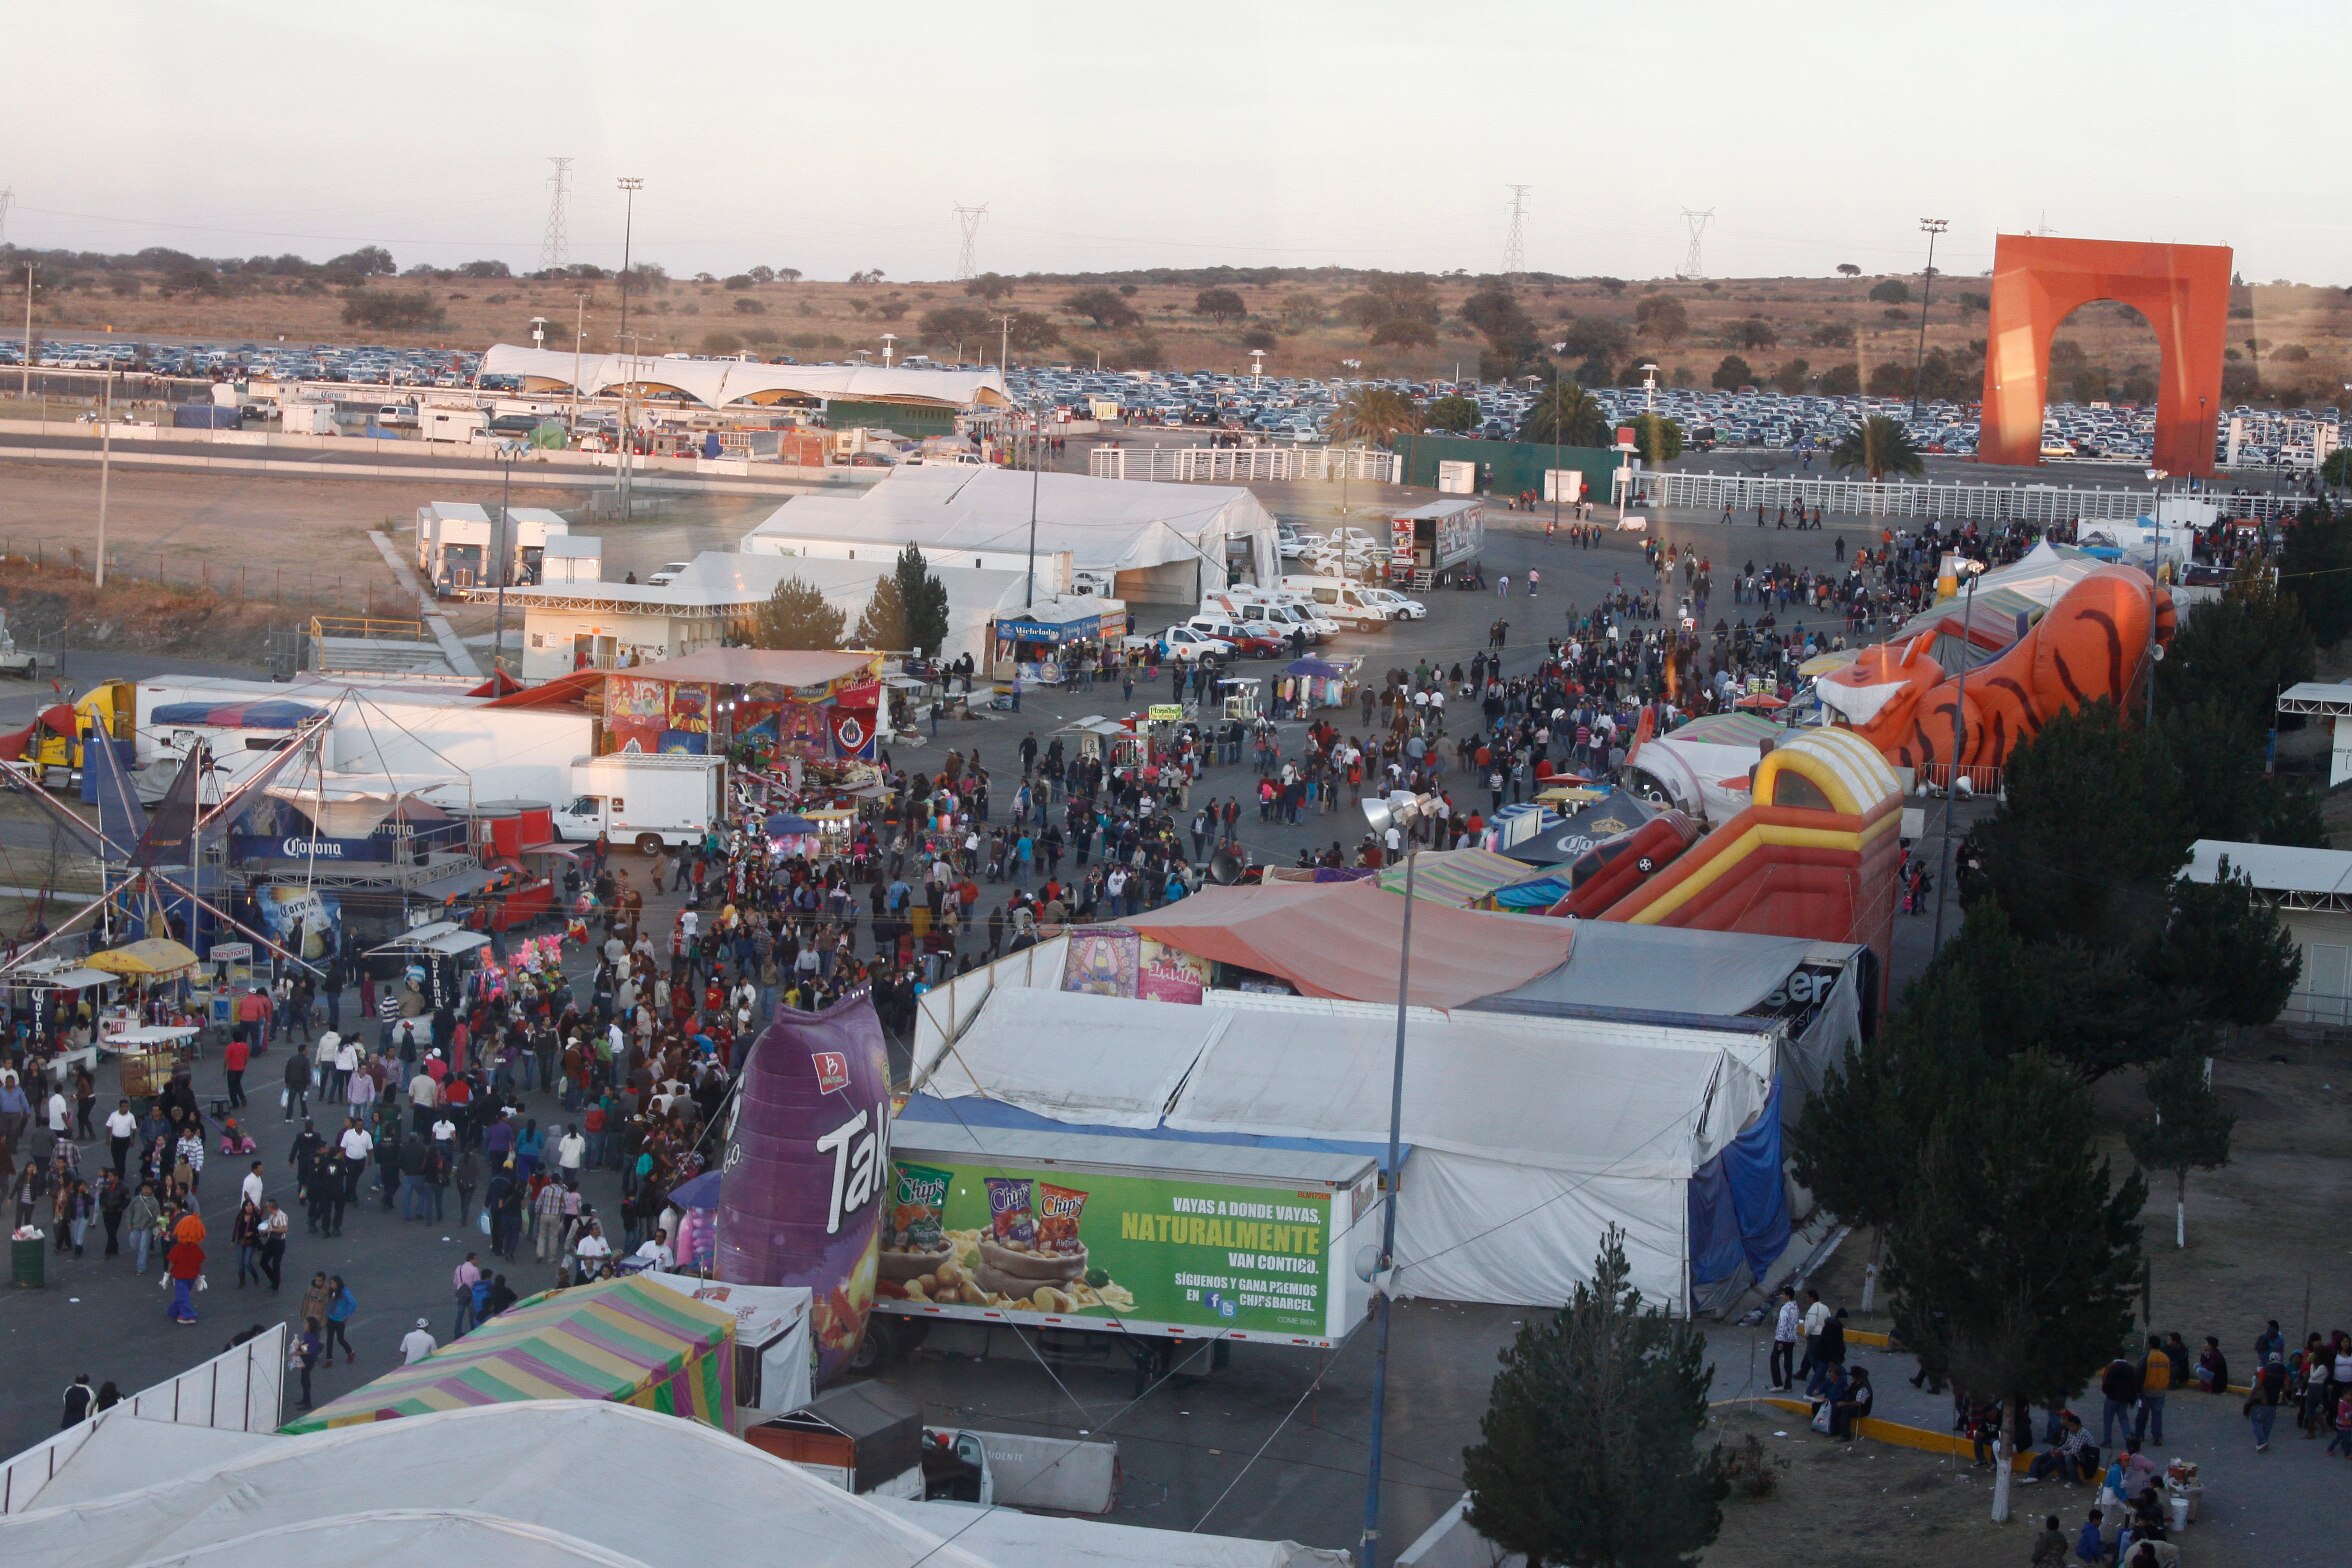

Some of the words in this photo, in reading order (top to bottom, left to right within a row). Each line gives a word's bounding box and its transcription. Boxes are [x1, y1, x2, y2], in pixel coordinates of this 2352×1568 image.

[1015, 627, 1060, 636] Micheladas
[843, 678, 876, 693] MINNIE
[372, 821, 415, 838] orona
[283, 837, 342, 859] Corona
[896, 1178, 946, 1206] Chip's
[990, 1183, 1031, 1212] Chip's
[1041, 1195, 1084, 1218] Chip's
[1173, 1198, 1215, 1215] VAYAS
[1217, 1201, 1227, 1216] A
[1229, 1202, 1273, 1220] DONDE
[1276, 1206, 1322, 1225] VAYAS,
[1122, 1212, 1320, 1255] NATURALMENTE
[1228, 1252, 1255, 1268] VAN
[1257, 1255, 1319, 1274] CONTIGO.
[1175, 1271, 1228, 1289] SÍGUENOS
[1230, 1278, 1237, 1289] Y
[1238, 1279, 1268, 1293] GANA
[1269, 1281, 1318, 1297] PREMIOS
[1186, 1289, 1200, 1302] EN
[1277, 1316, 1298, 1325] COME
[1299, 1318, 1317, 1327] BIEN
